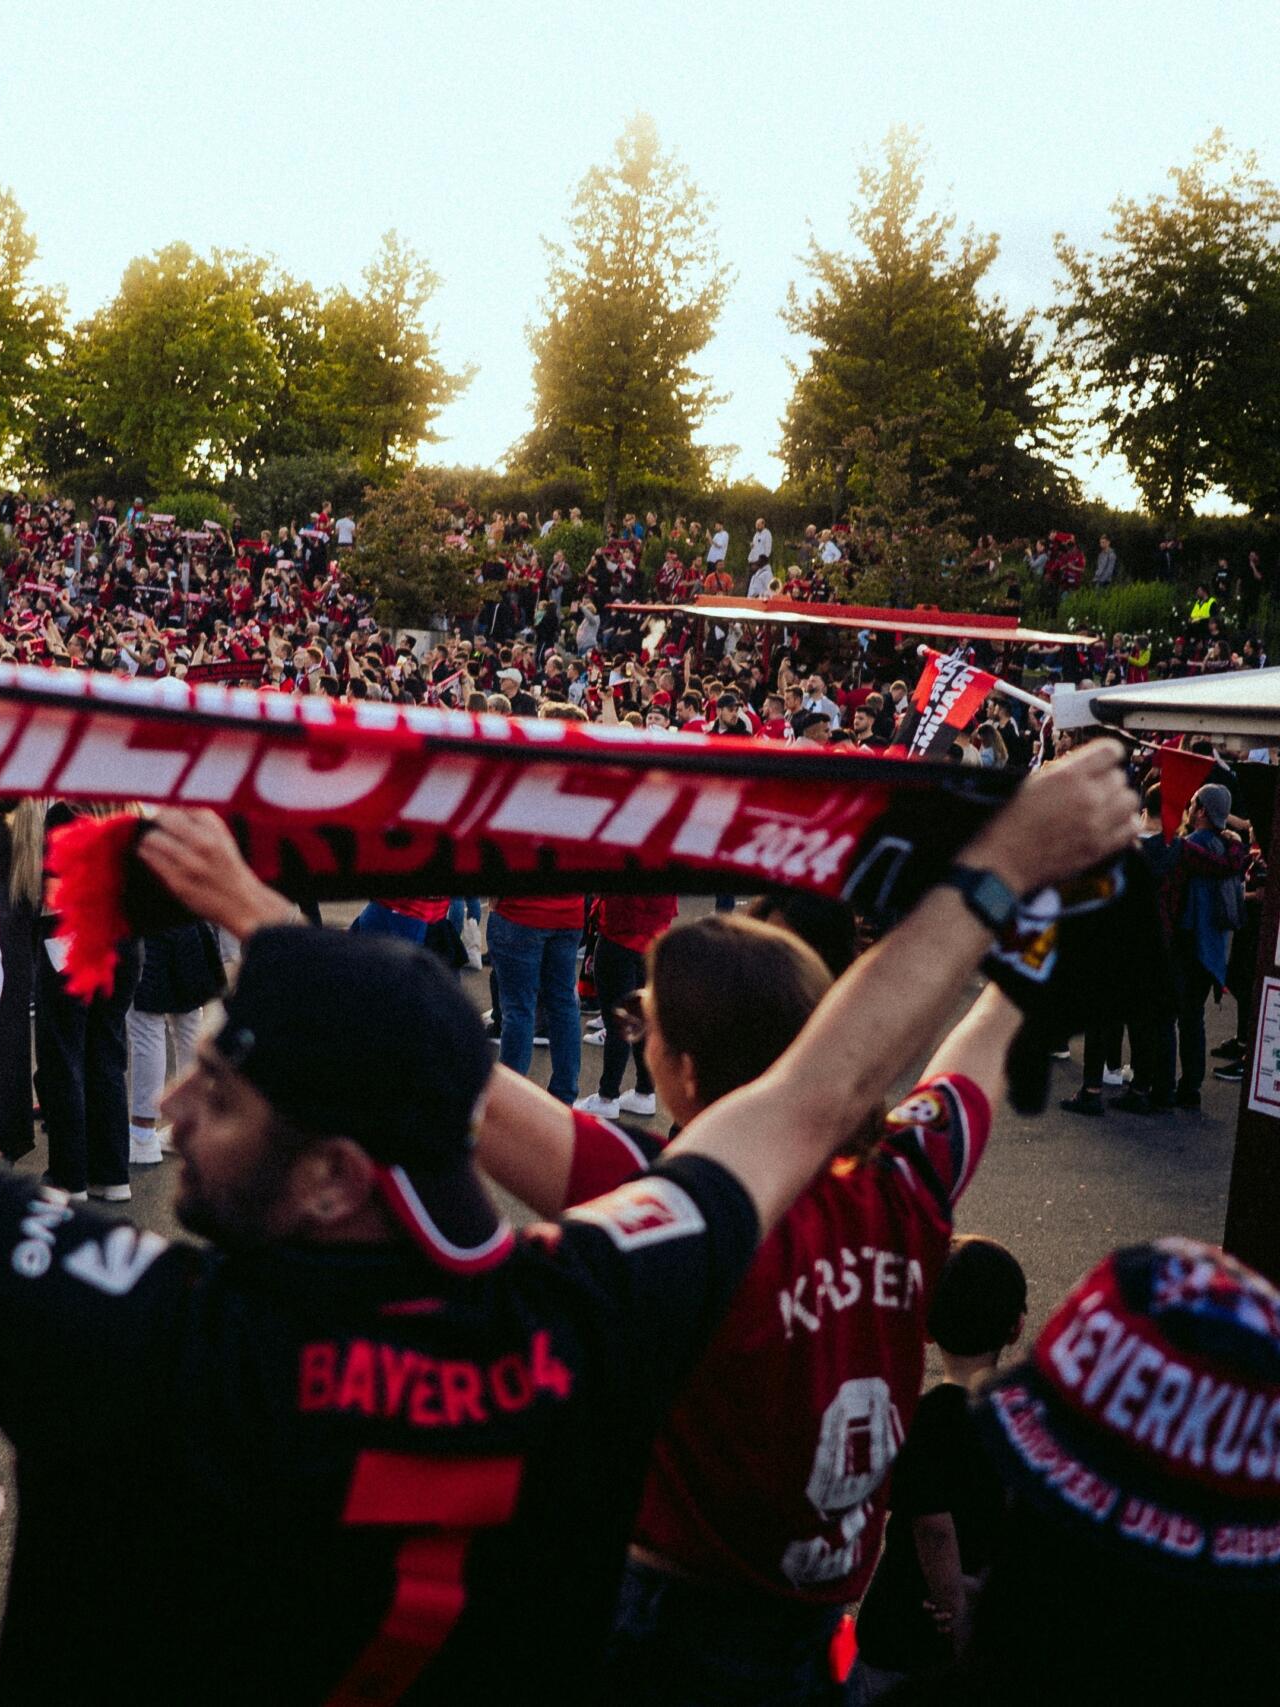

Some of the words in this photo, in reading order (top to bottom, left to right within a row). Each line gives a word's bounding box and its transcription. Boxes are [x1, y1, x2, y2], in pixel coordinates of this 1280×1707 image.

[731, 821, 855, 884] 2024
[298, 1338, 489, 1427] BAYER
[489, 1329, 574, 1413] 04
